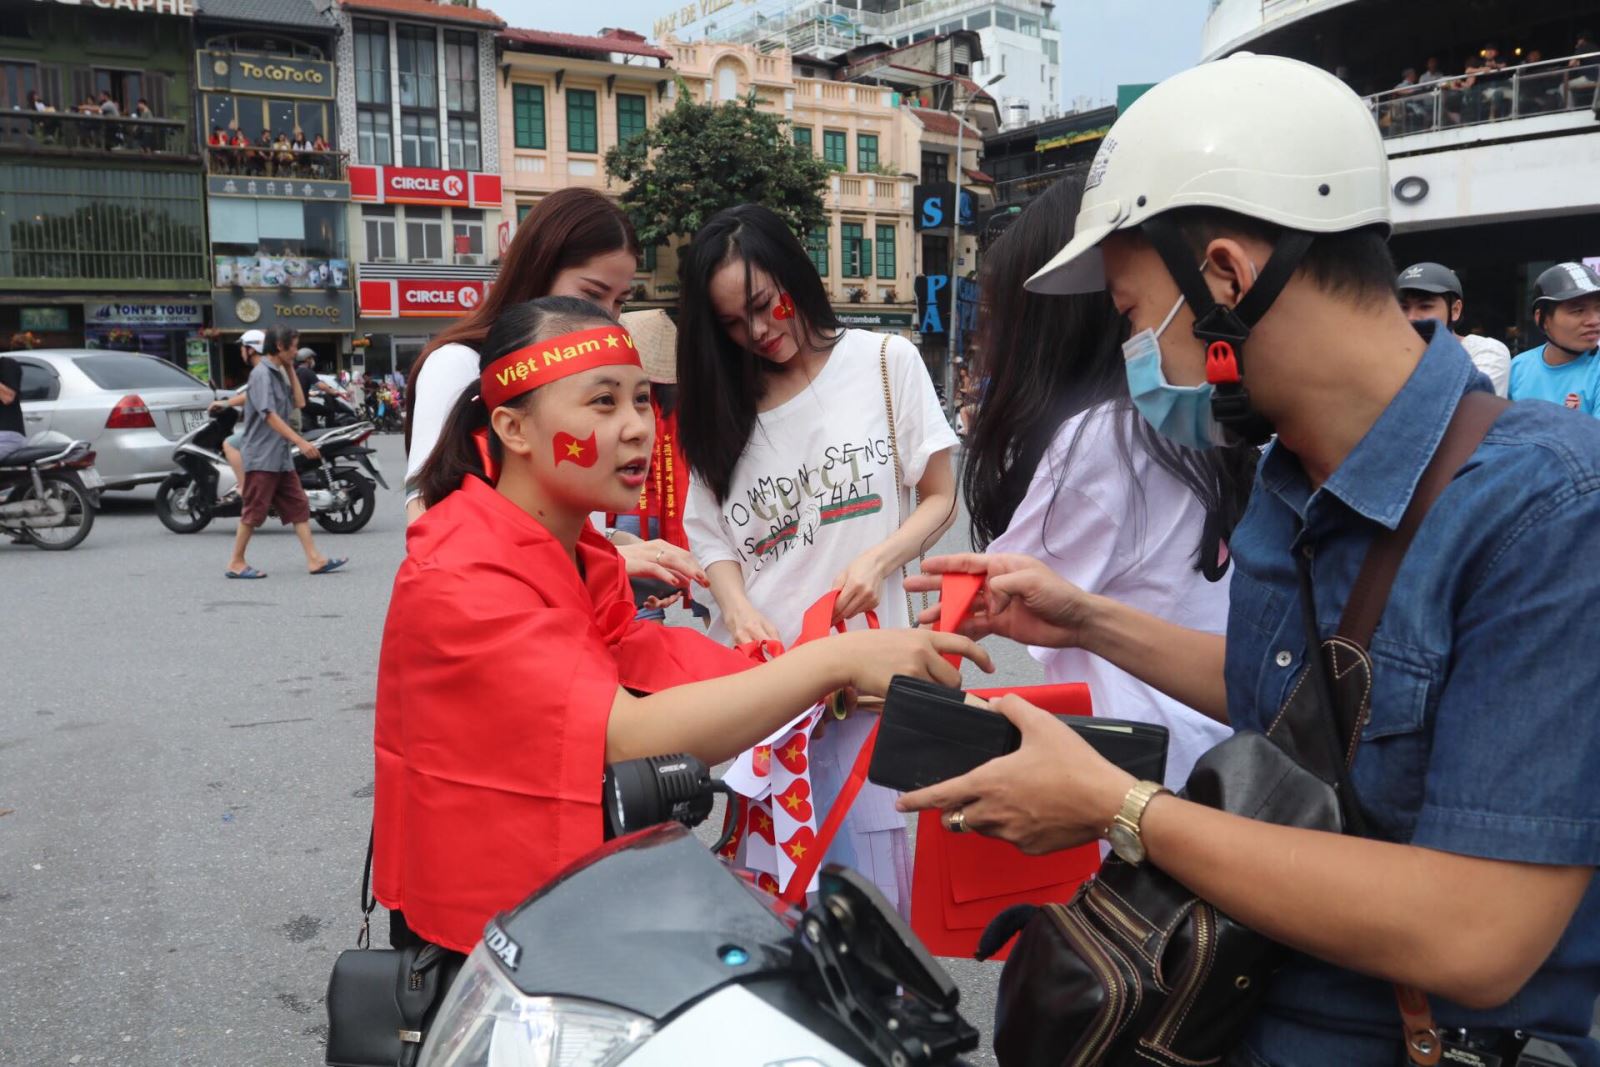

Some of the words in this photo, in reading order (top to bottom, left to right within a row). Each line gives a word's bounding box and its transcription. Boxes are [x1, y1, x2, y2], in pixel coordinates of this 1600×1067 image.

[391, 176, 441, 191] CIRCLE
[444, 176, 463, 196] K
[405, 289, 455, 303] CIRCLE
[458, 287, 478, 307] K
[114, 304, 157, 315] TONY'S
[160, 304, 198, 315] TOURS
[496, 357, 540, 387] Việt
[542, 339, 601, 367] Nam
[737, 537, 757, 562] IS
[815, 473, 874, 511] THAT
